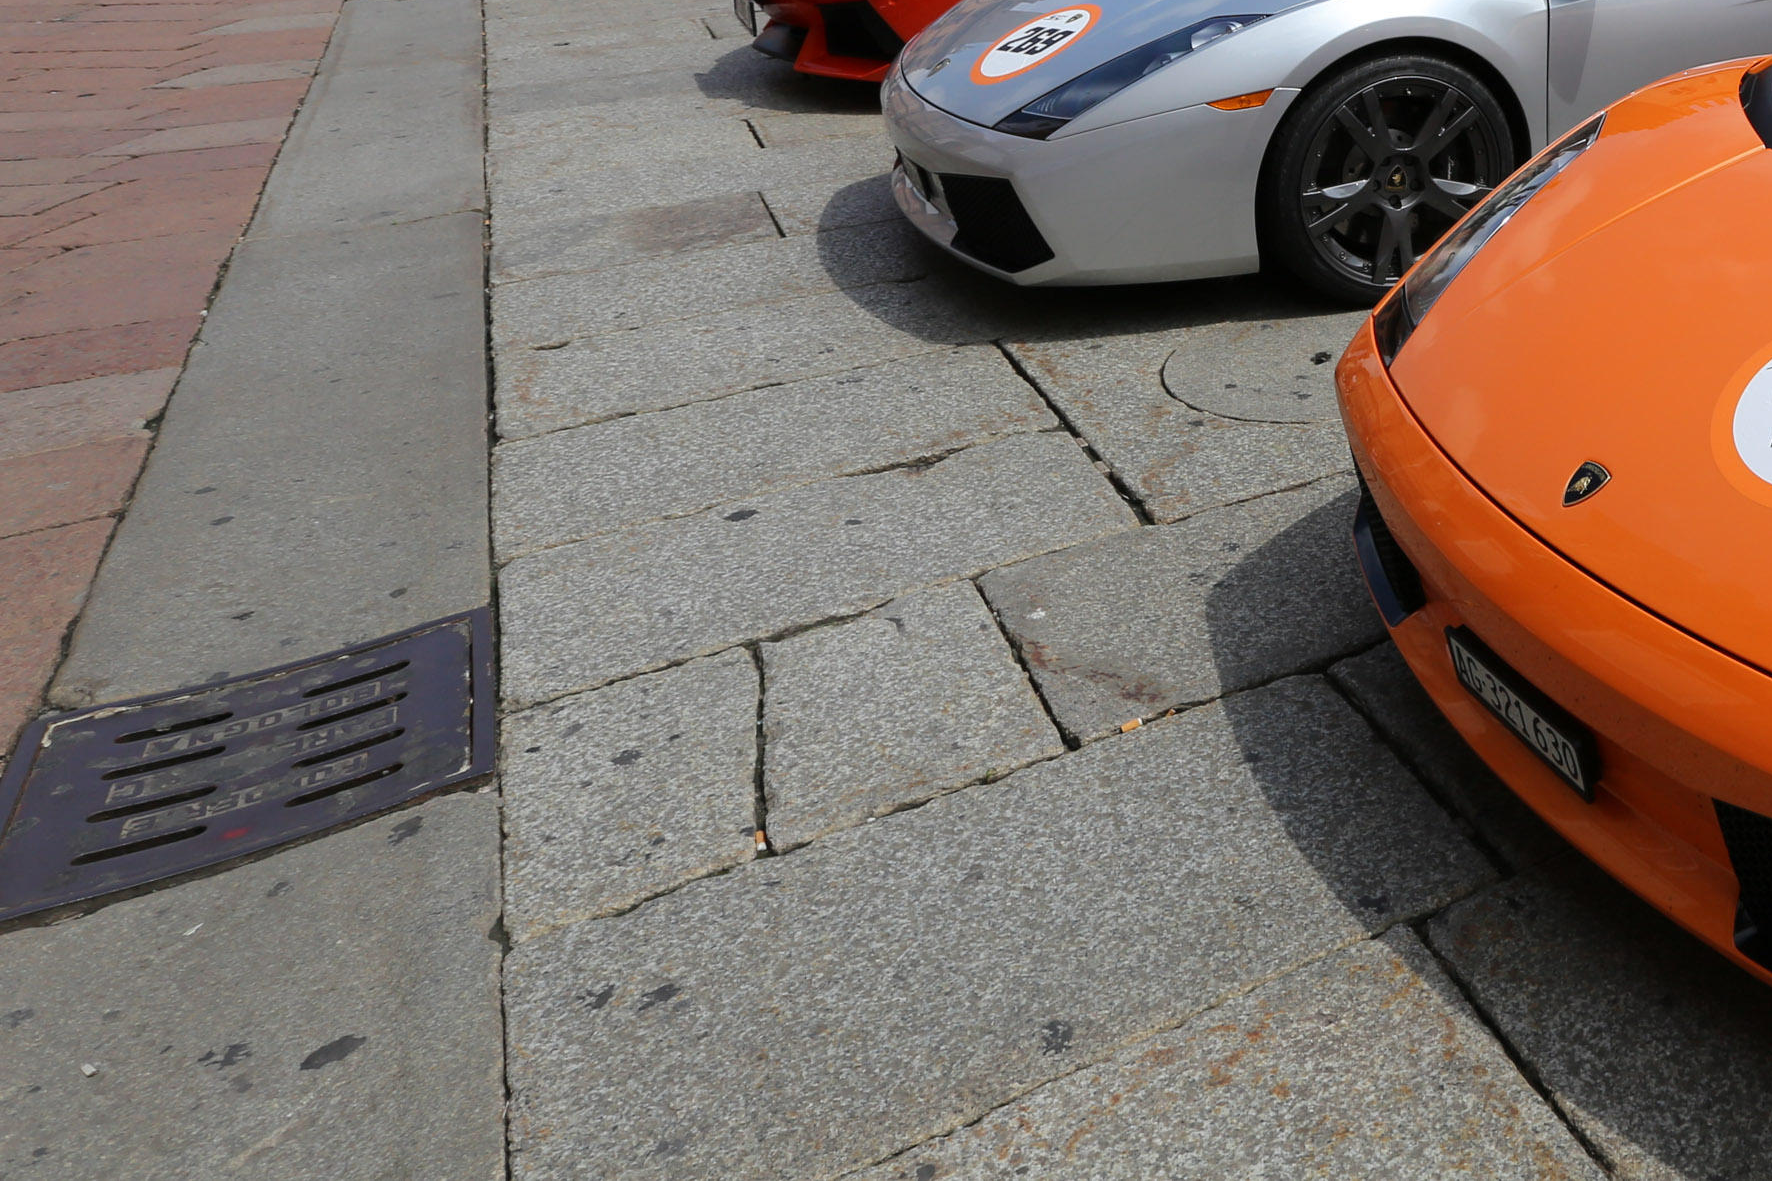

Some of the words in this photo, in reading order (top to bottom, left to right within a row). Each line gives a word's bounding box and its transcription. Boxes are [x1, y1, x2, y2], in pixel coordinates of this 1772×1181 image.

[995, 26, 1076, 56] 269
[148, 682, 376, 757] BOLOGNA
[127, 754, 360, 837] FODERE
